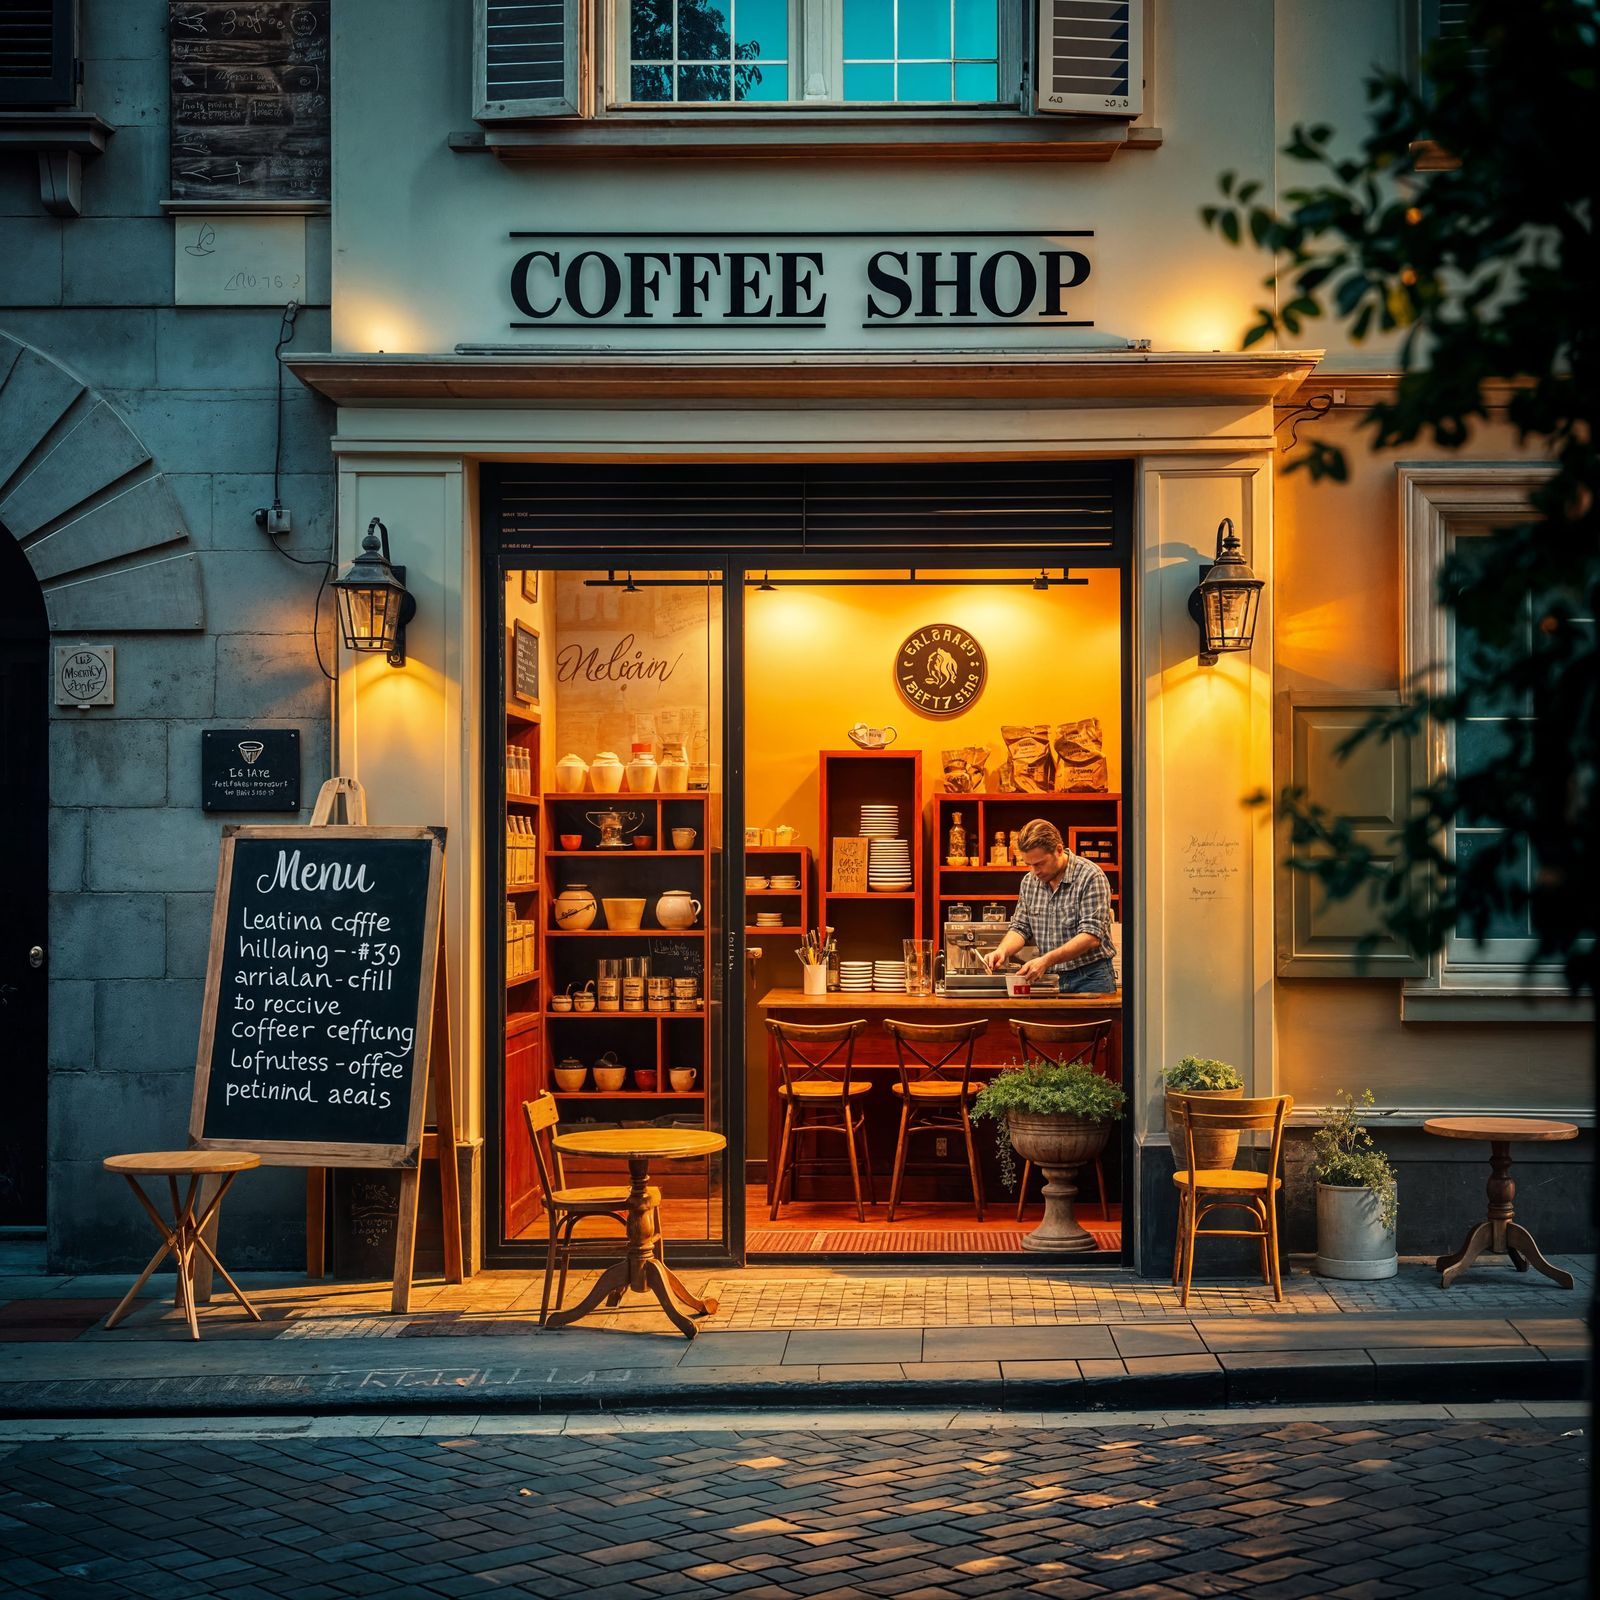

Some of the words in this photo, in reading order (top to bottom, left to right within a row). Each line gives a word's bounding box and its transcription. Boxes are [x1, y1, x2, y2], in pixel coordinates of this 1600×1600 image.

[510, 250, 827, 319] COFFEE
[866, 250, 1092, 319] SHOP
[256, 849, 375, 894] Menu
[243, 906, 323, 930] Leatina
[239, 935, 329, 968] hillaing
[234, 993, 255, 1011] to
